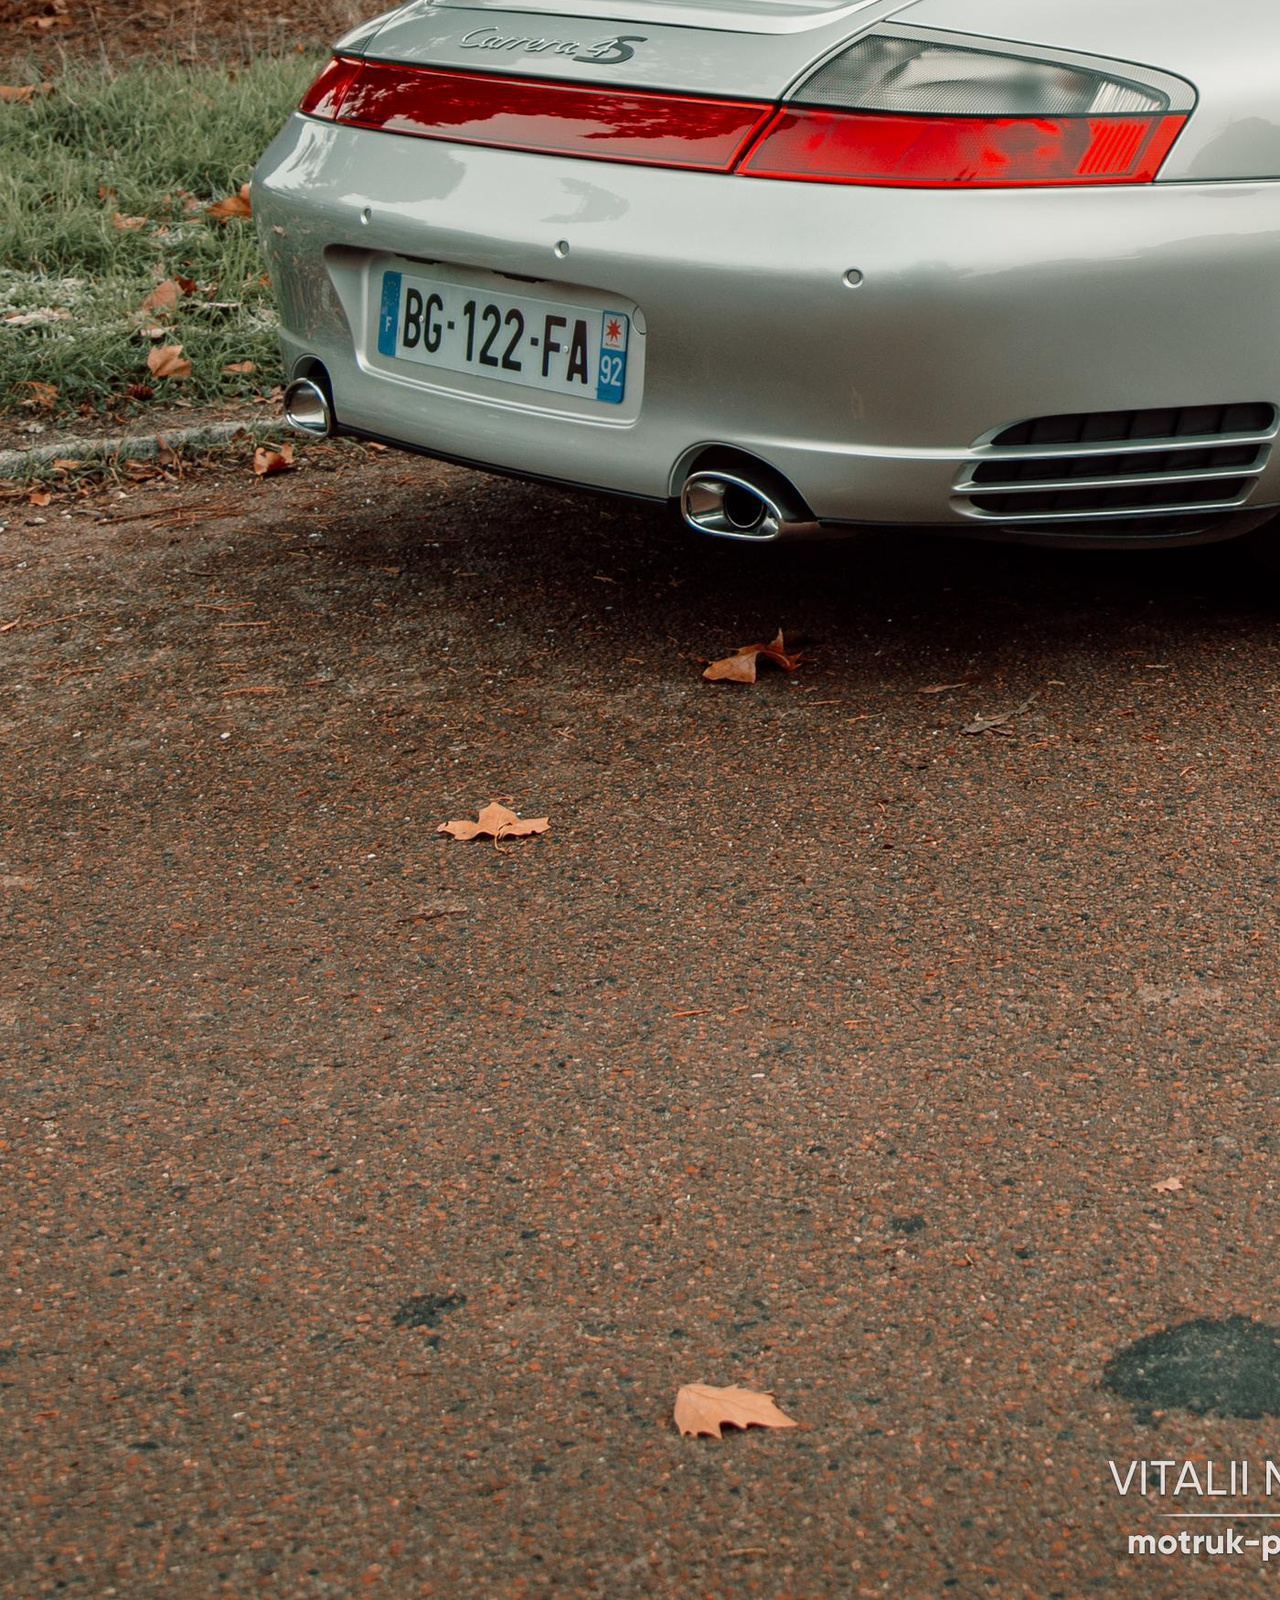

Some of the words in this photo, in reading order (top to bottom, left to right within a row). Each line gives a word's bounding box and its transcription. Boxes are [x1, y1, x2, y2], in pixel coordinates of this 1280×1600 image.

[459, 26, 582, 55] Carrera
[572, 35, 648, 65] 4S
[384, 315, 393, 333] F
[402, 287, 588, 385] BG-122-FA
[600, 354, 623, 387] 92
